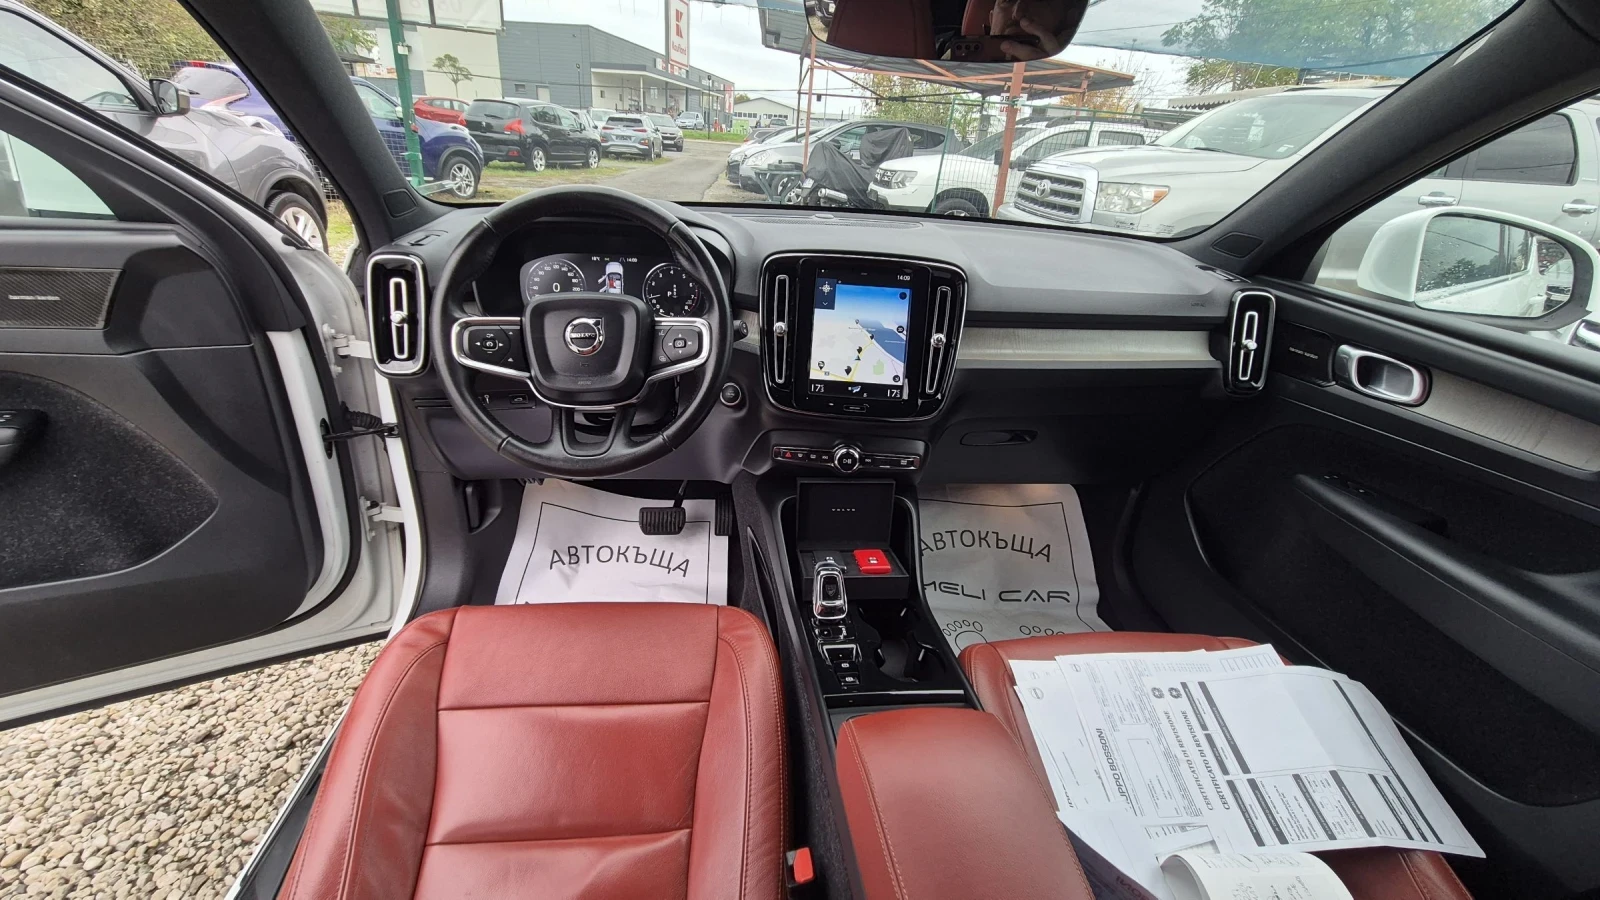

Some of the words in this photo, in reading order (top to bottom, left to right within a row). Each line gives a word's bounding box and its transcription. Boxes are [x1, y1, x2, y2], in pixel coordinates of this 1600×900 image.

[552, 282, 561, 293] 0
[549, 545, 691, 578] АВТОКЪЩА
[920, 529, 1051, 563] АВТОКЪЩА
[998, 589, 1071, 603] CAR
[1163, 710, 1186, 749] REVISIONE
[1180, 709, 1203, 748] REVISIONE
[1096, 728, 1117, 772] BOSSONI
[1181, 749, 1191, 758] DI
[1198, 748, 1208, 758] DI
[1186, 758, 1215, 811] CERTIFICATO
[1202, 758, 1231, 811] CERTIFICATO
